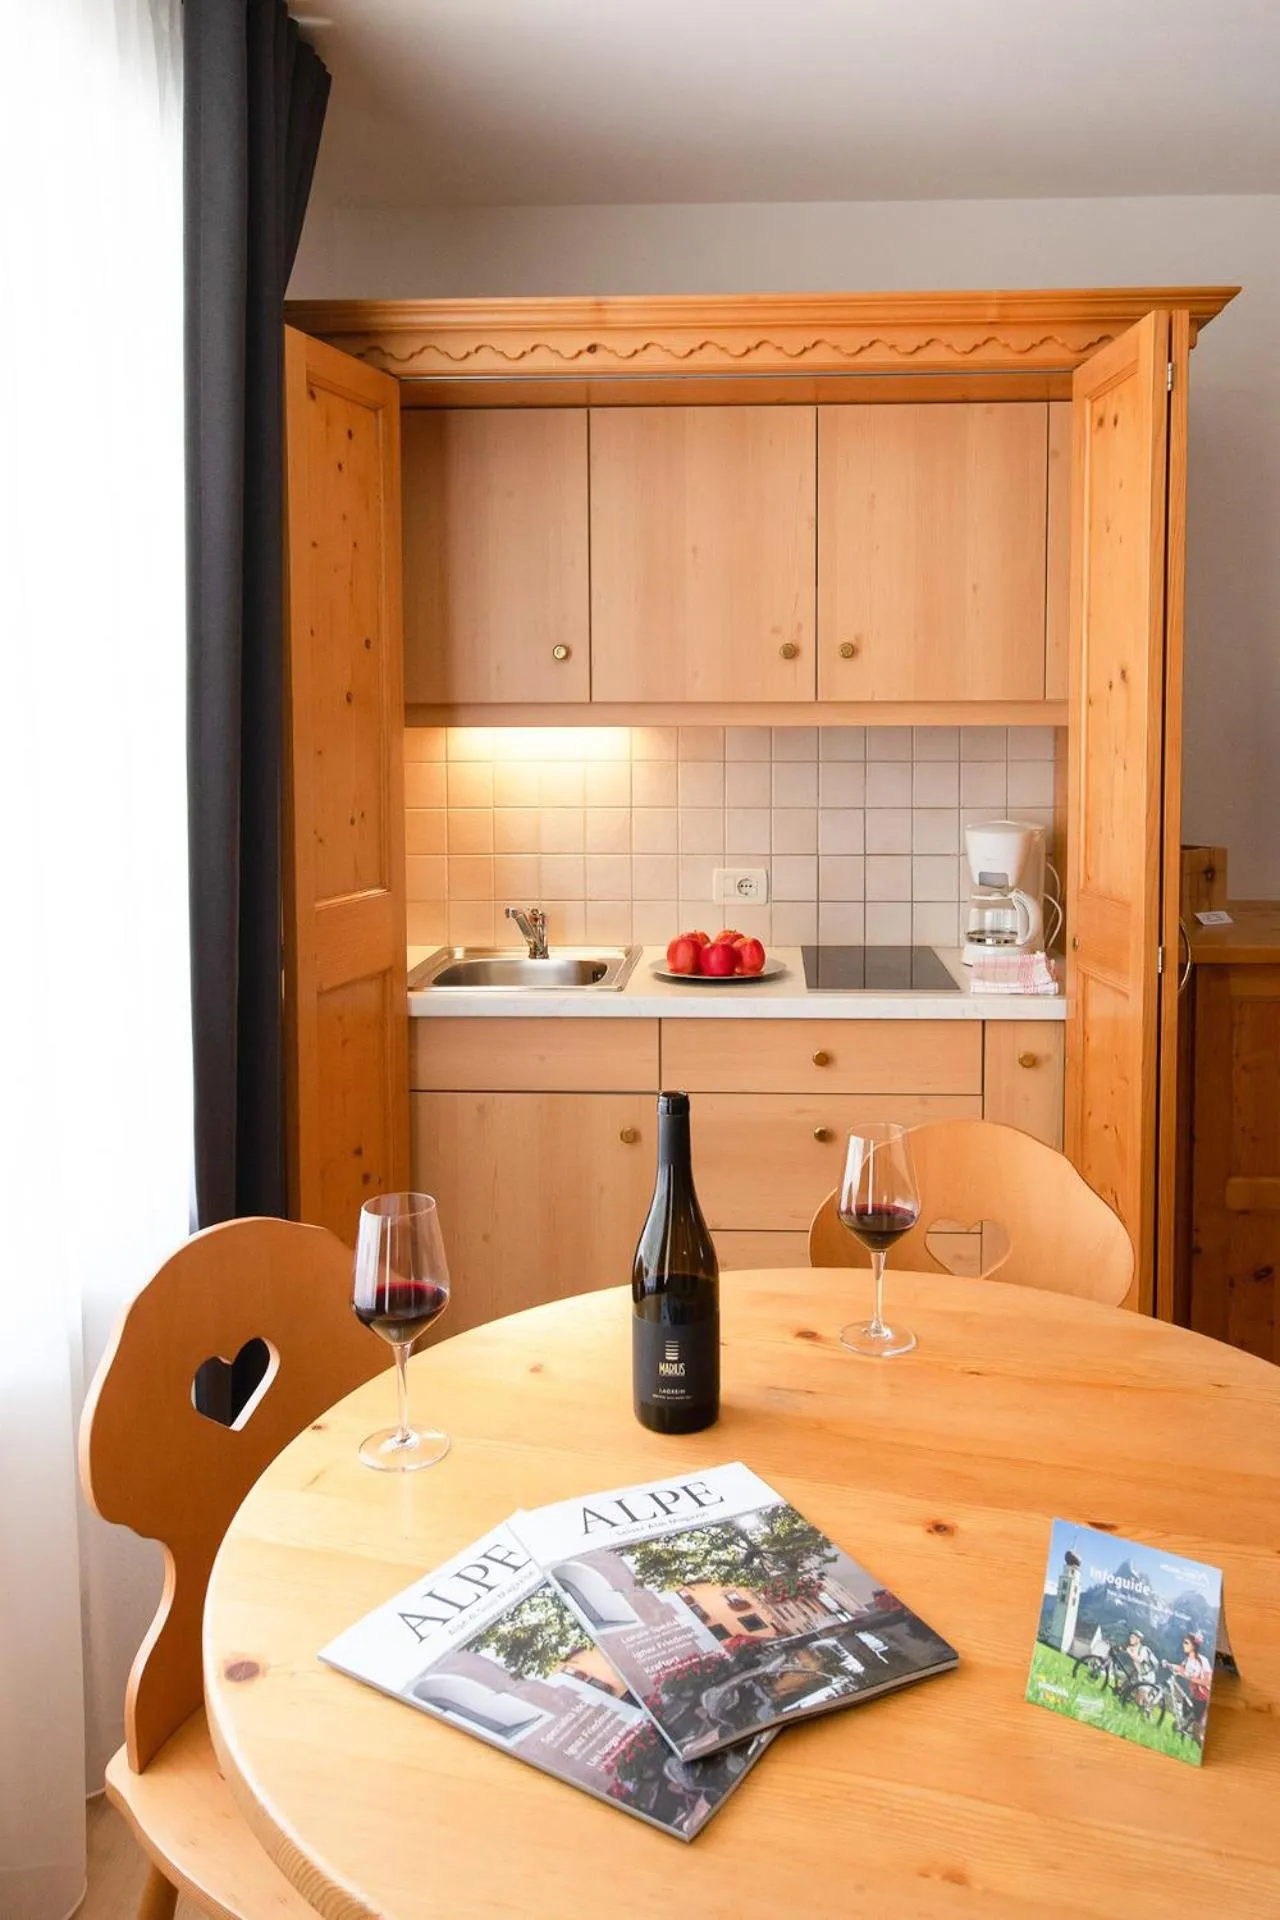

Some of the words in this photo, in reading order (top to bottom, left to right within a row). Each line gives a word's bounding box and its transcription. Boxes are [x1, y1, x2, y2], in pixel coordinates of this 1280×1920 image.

[581, 1481, 725, 1536] ALPE
[398, 1544, 532, 1644] ALPE
[1090, 1566, 1151, 1597] Infoguide
